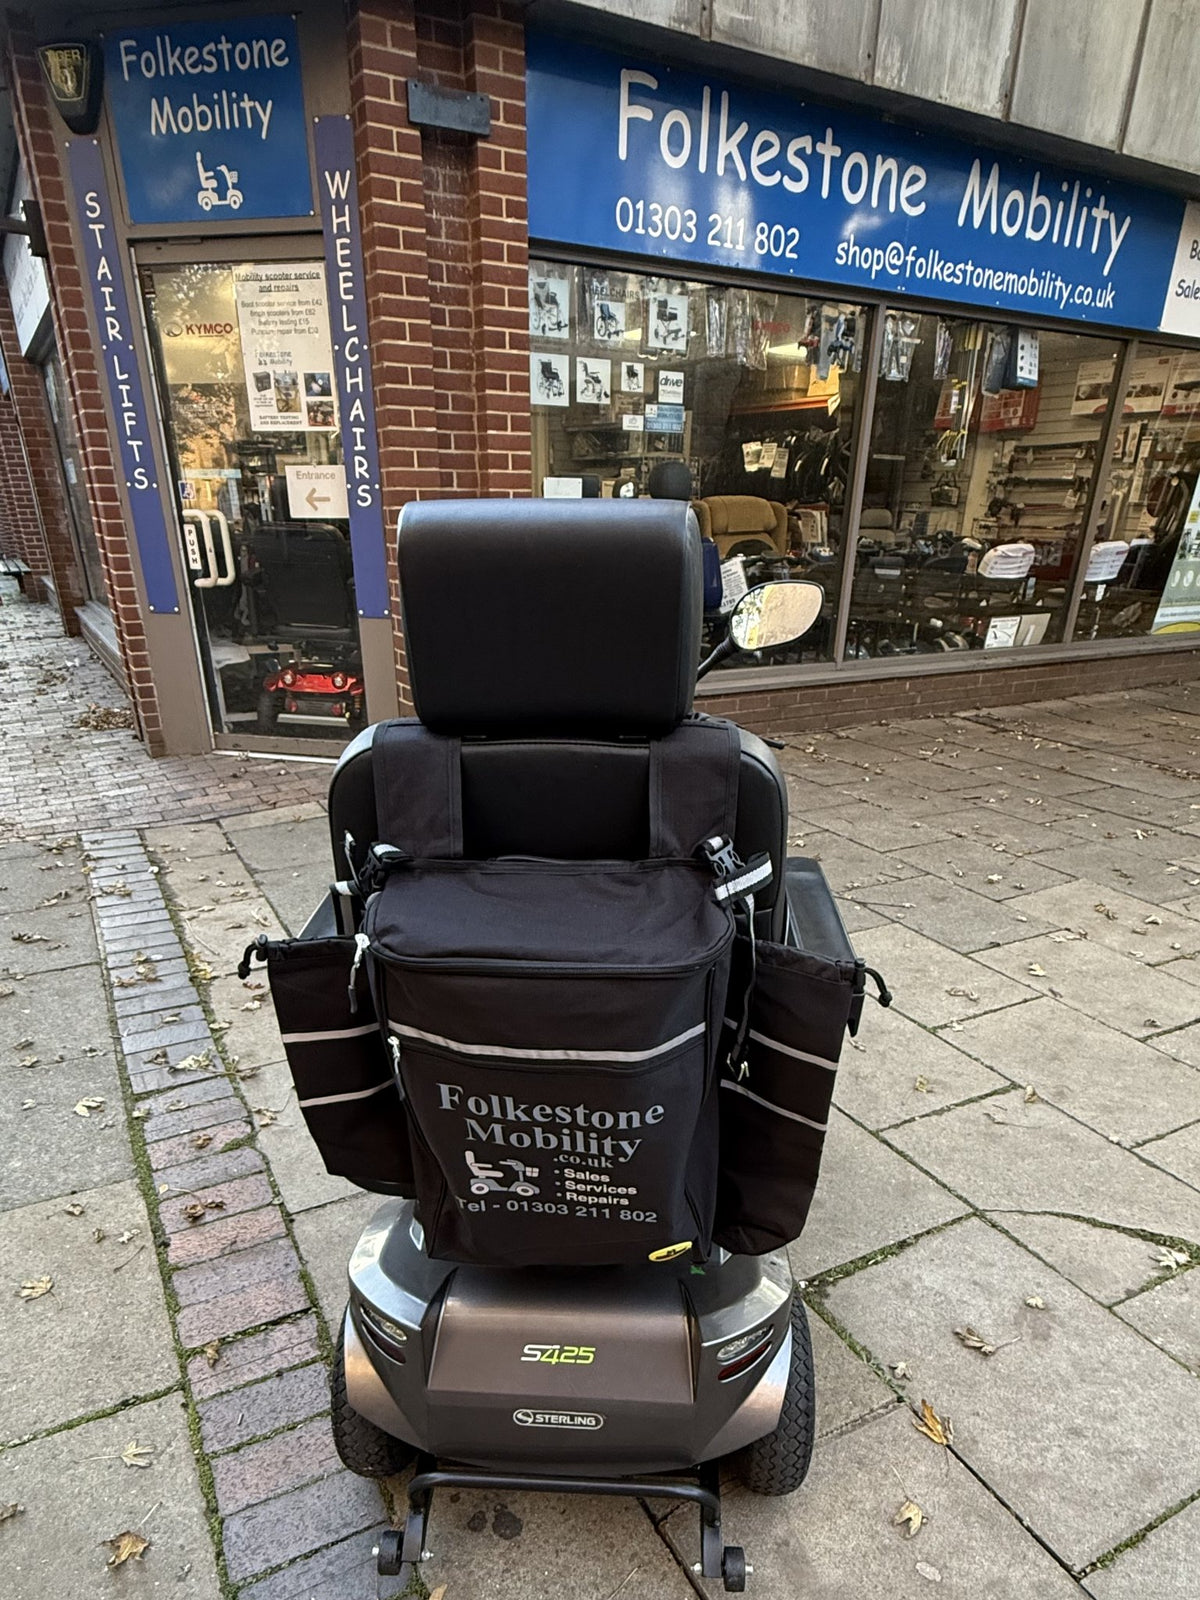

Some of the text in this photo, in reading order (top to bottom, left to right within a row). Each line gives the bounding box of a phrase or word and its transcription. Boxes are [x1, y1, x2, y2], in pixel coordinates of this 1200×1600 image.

[119, 37, 290, 81] Folkestone
[150, 92, 273, 140] Mobility
[618, 69, 1132, 277] Folkestone Mobility
[615, 196, 800, 260] 01303 211 802
[265, 271, 292, 280] scooter
[294, 270, 321, 280] service
[835, 233, 1115, 311] shop@folkestonemobility.co.uk
[259, 282, 300, 292] and repairs
[185, 322, 234, 335] KYMCO
[324, 169, 372, 507] WHEELCHAIRS
[85, 191, 149, 490] STAIR LIFTS
[660, 375, 683, 387] drive
[296, 471, 336, 481] Entrance
[187, 529, 198, 565] PUSH
[436, 1083, 664, 1130] Folkestone
[464, 1118, 642, 1163] Mobility
[553, 1153, 614, 1169] .co.uk
[563, 1168, 610, 1183] Sales
[565, 1180, 637, 1195] Services
[566, 1192, 630, 1206] Repairs
[506, 1200, 569, 1215] 01303
[575, 1205, 611, 1219] 211
[620, 1209, 658, 1223] 802
[520, 1344, 596, 1365] S425
[535, 1414, 596, 1426] STERLING
